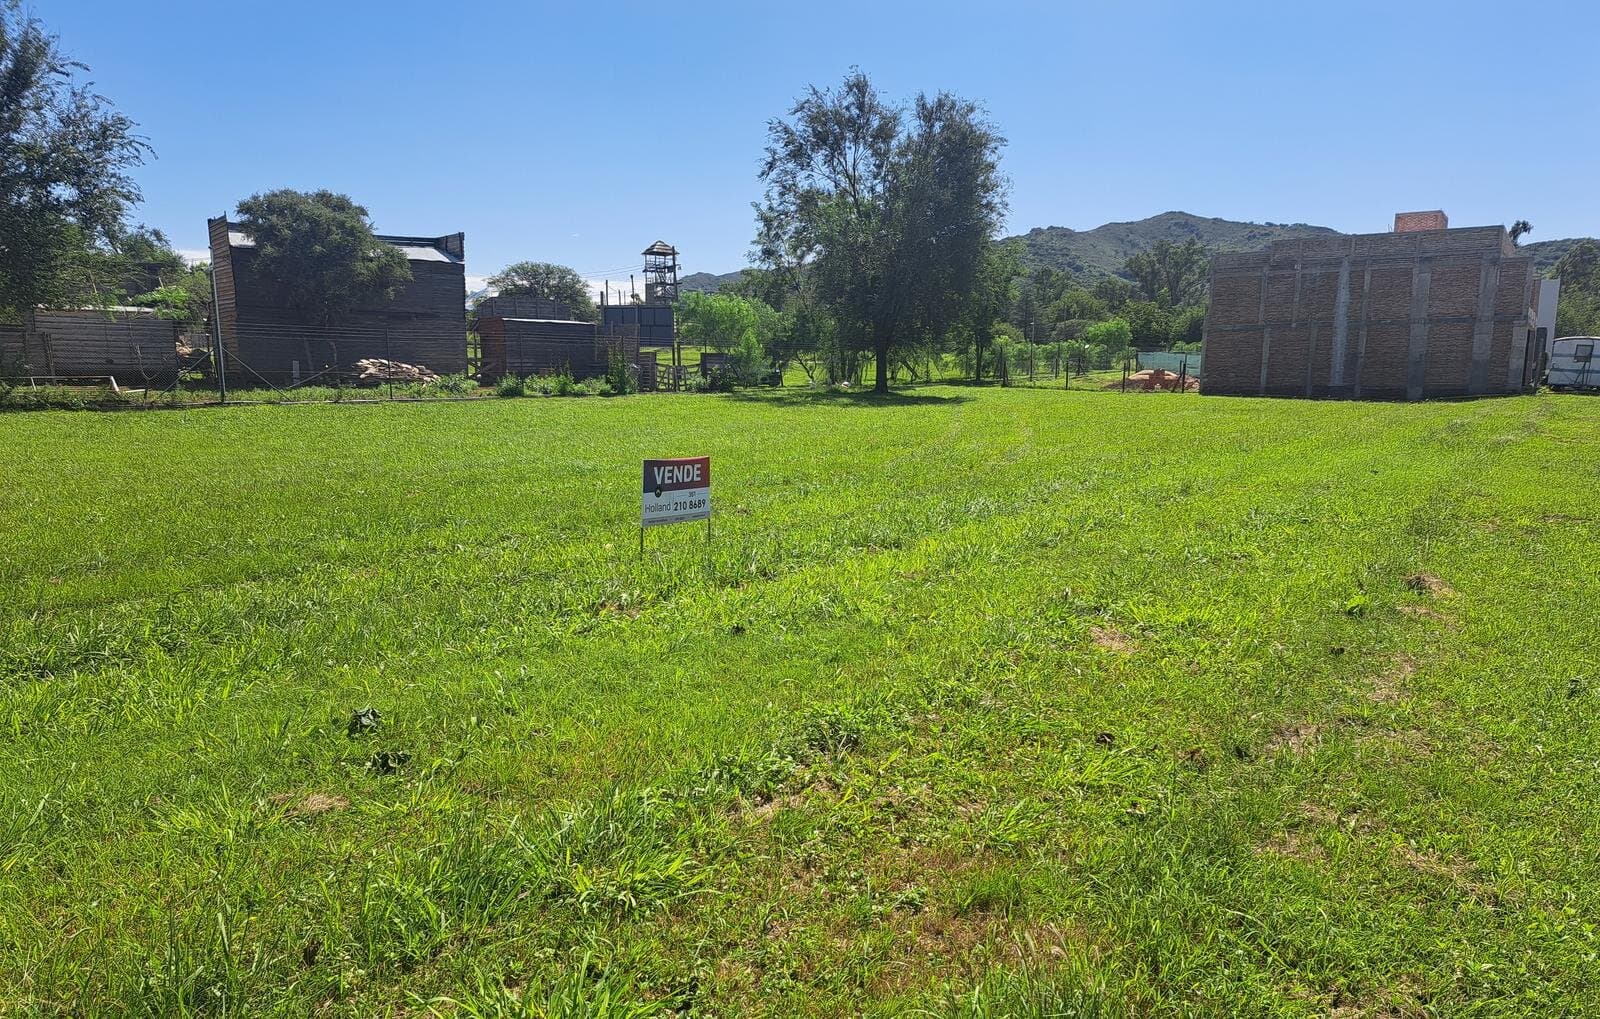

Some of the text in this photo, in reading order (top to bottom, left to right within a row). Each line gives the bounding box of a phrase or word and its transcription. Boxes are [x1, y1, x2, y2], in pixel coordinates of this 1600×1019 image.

[654, 464, 702, 485] VENDE
[644, 498, 706, 513] Holland 210 8689
